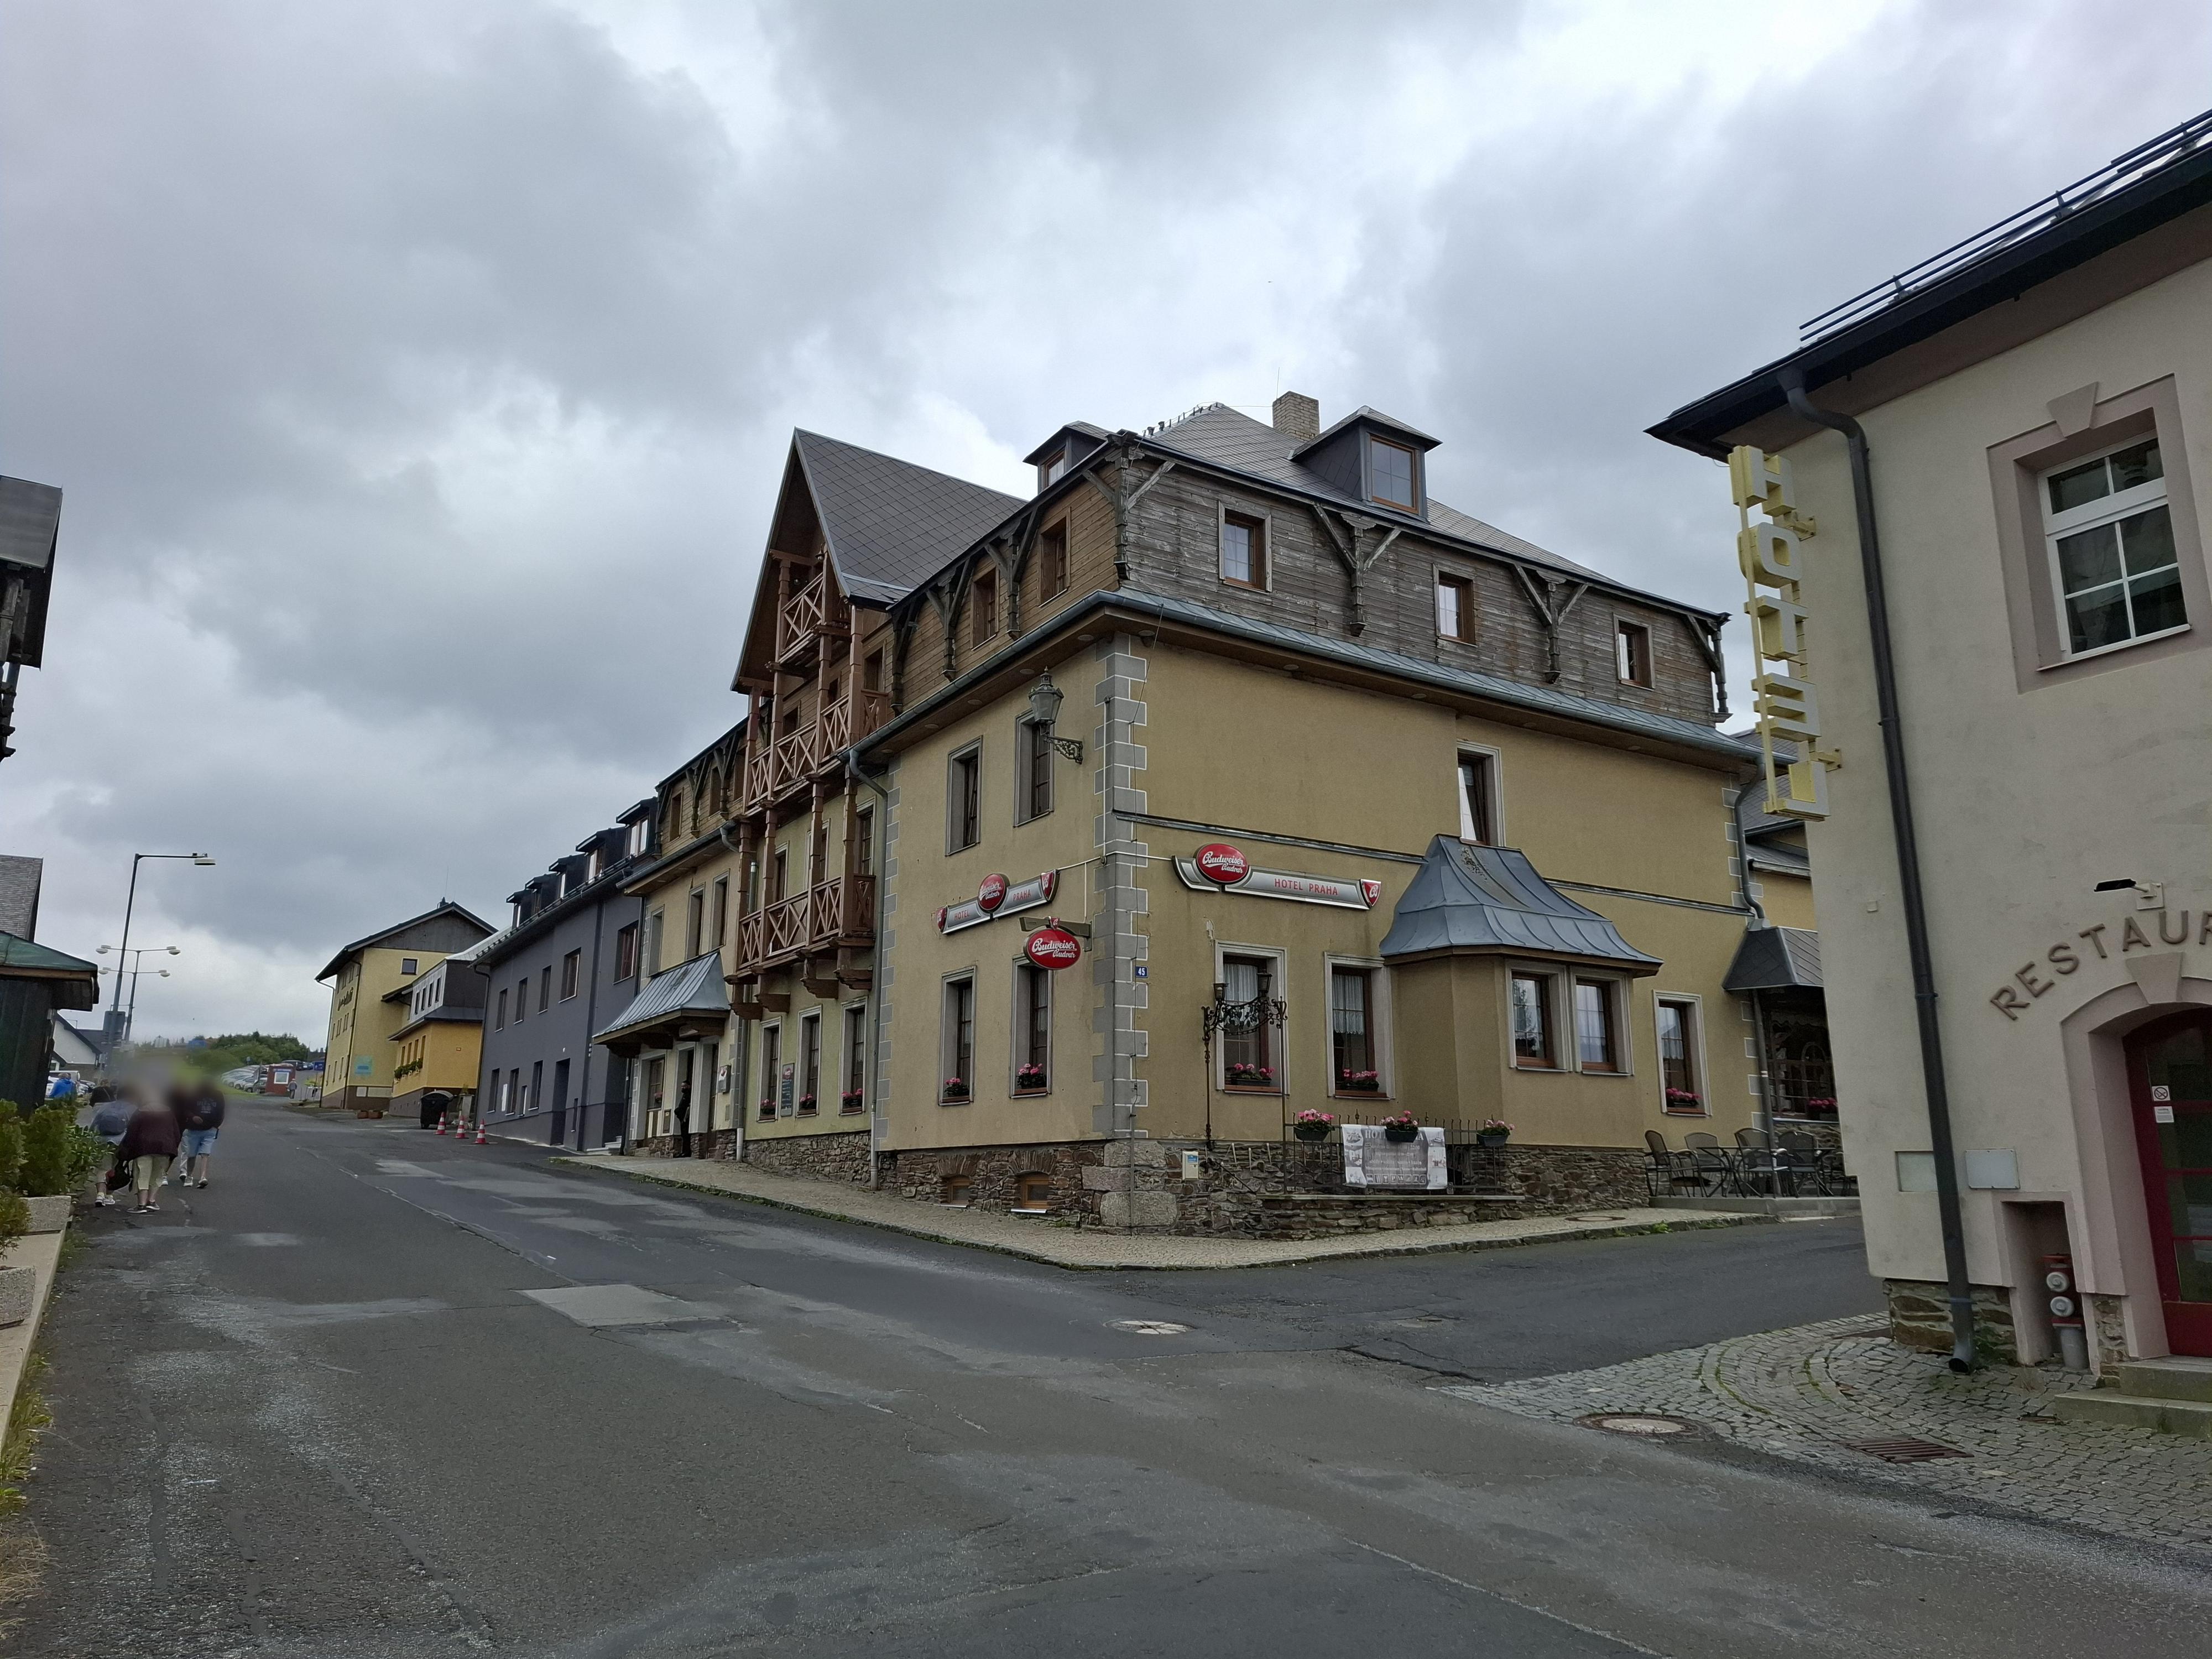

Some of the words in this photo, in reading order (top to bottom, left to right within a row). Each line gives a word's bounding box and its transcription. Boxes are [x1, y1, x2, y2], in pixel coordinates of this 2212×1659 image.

[1729, 445, 1830, 821] HOTEL
[1202, 851, 1245, 867] Budweiser
[1221, 863, 1243, 874] Budvar
[1275, 878, 1303, 891] HOTEL
[1309, 883, 1338, 896] PRAHA
[954, 909, 969, 921] HOTEL
[1013, 889, 1031, 902] PRAHA
[1032, 938, 1077, 953] Budweiser
[1052, 948, 1076, 958] Budvar
[1138, 967, 1145, 975] 45
